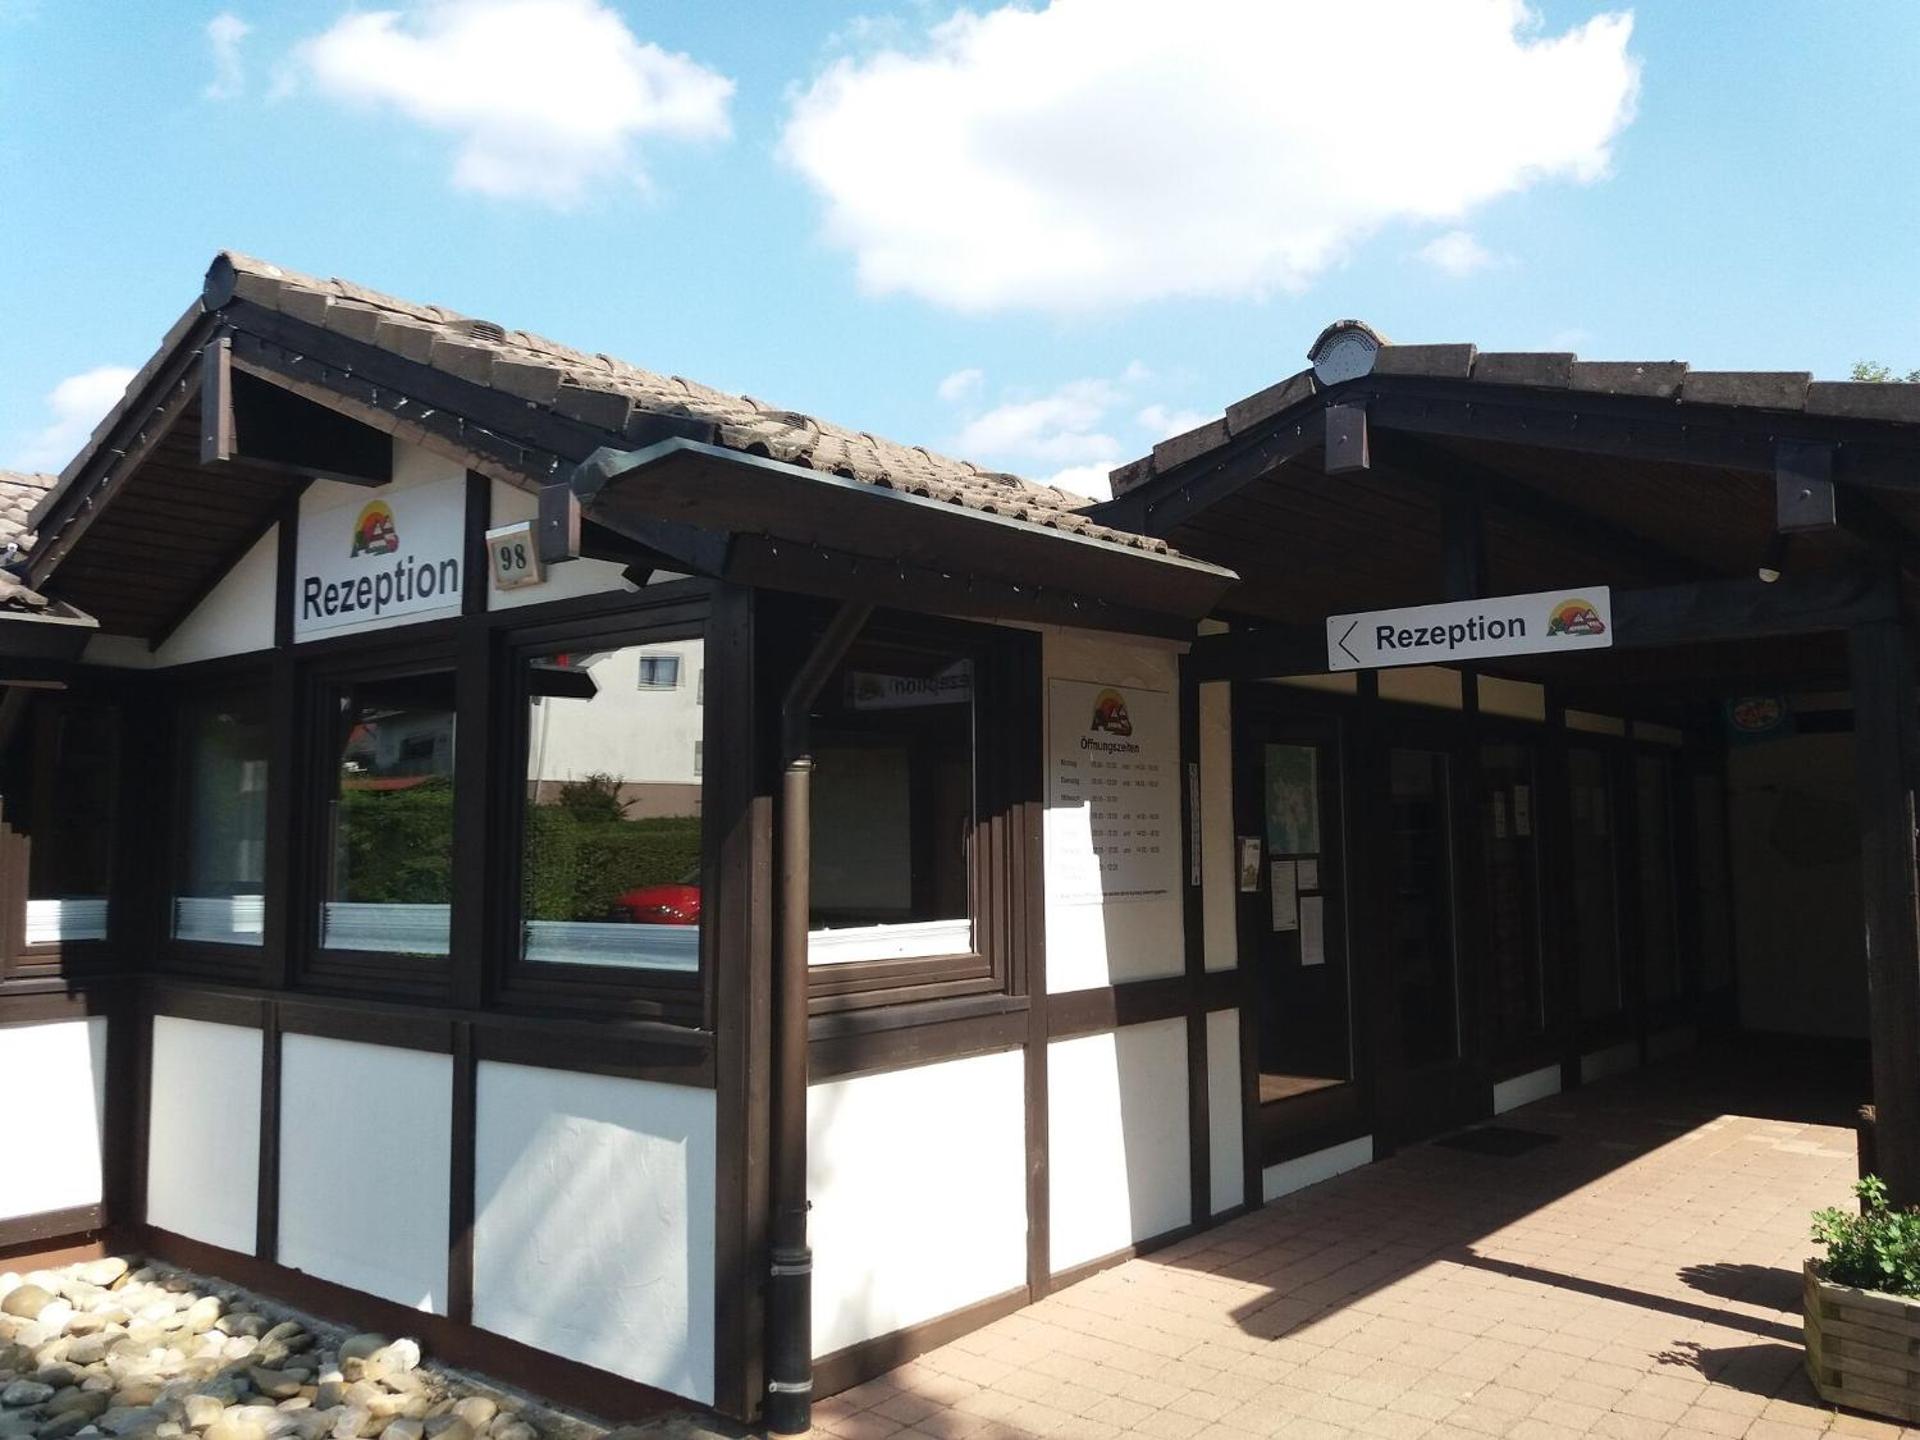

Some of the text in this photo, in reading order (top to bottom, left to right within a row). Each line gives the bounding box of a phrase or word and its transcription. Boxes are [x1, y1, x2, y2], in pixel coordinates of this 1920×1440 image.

[499, 543, 528, 571] 98
[303, 555, 458, 620] Rezeption
[1375, 615, 1526, 650] Rezeption
